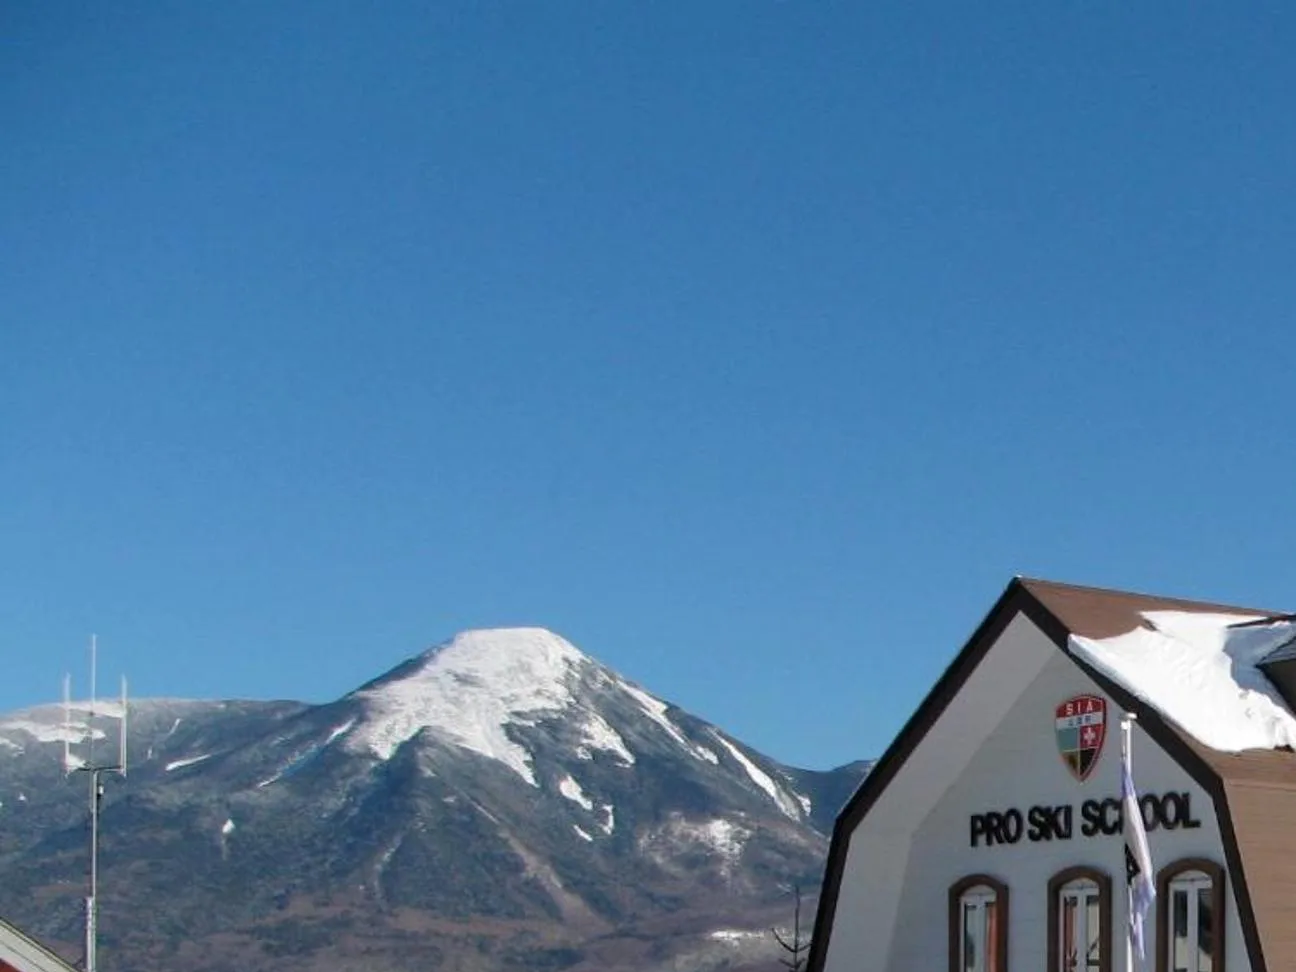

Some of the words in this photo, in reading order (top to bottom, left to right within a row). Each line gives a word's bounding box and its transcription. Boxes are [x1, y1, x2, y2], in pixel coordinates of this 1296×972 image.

[1066, 700, 1093, 715] SIA
[970, 808, 1023, 848] PRO
[1028, 805, 1073, 842] SKI
